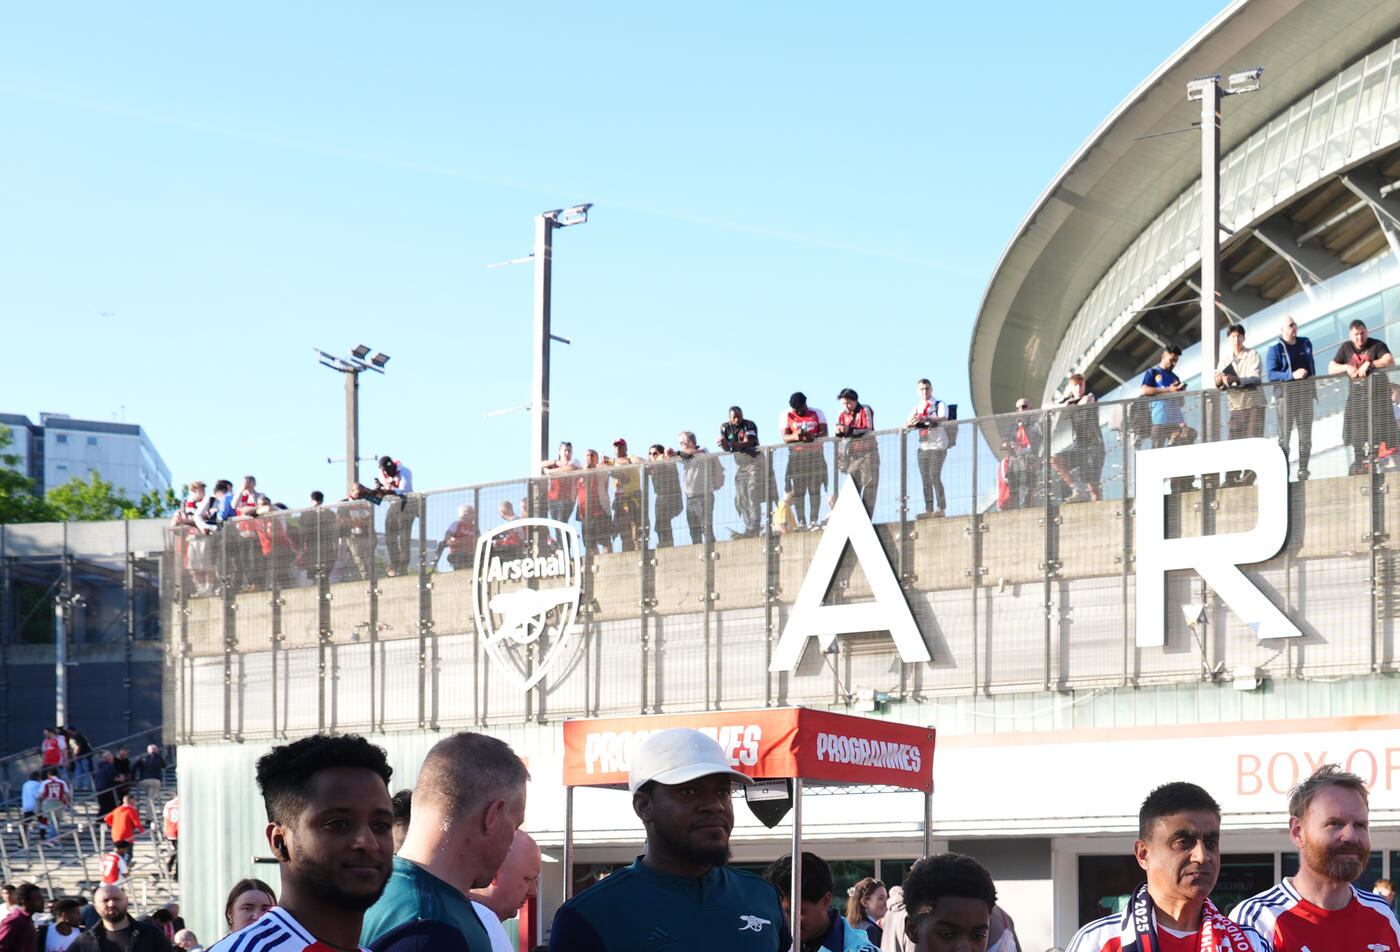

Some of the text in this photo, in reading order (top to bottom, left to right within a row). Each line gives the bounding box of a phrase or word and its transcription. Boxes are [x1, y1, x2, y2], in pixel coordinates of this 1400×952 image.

[487, 550, 565, 582] Arsenal
[816, 732, 921, 773] PROGRAMMES
[1236, 751, 1329, 796] BOX
[1135, 899, 1150, 932] 2025
